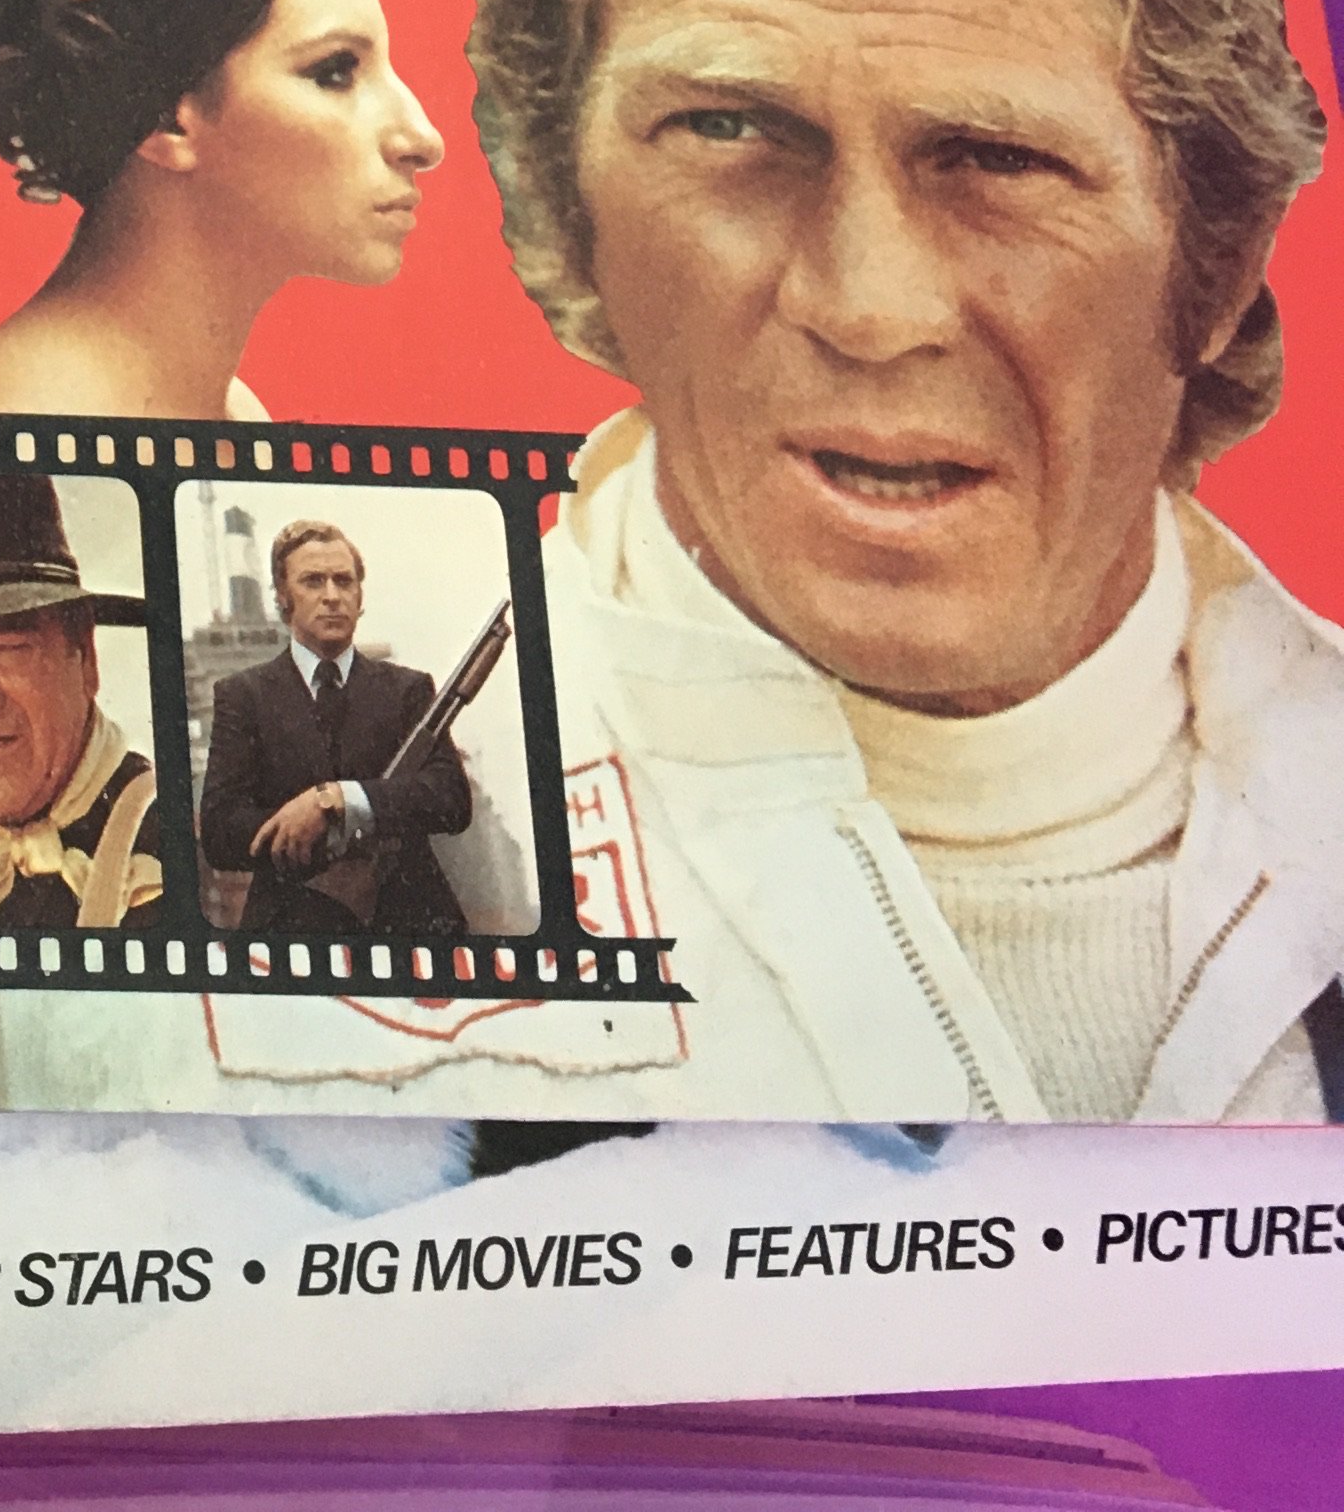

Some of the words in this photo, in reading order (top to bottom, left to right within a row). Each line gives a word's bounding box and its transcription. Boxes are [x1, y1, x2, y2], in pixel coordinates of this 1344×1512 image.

[14, 1247, 213, 1309] STARS
[297, 1238, 400, 1297] BIG
[412, 1231, 643, 1292] MOVIES
[723, 1216, 1017, 1281] FEATURES
